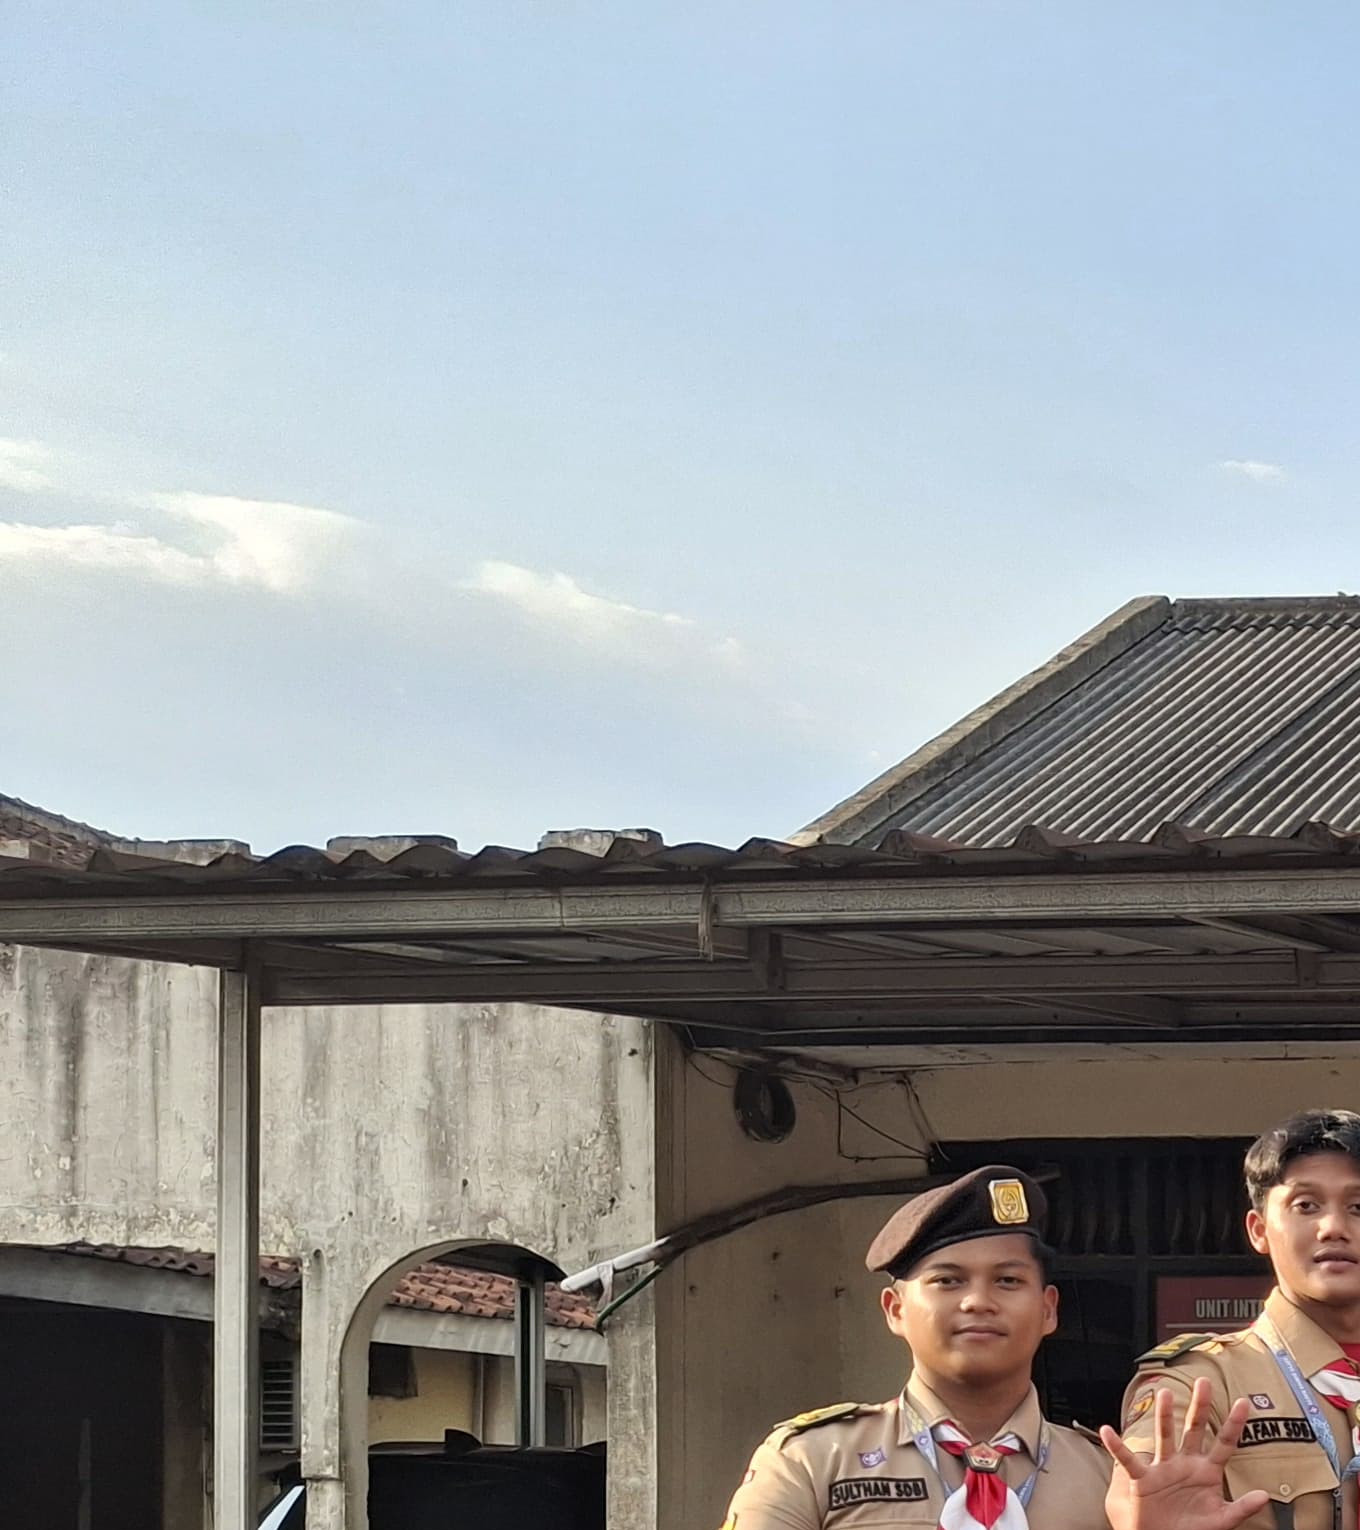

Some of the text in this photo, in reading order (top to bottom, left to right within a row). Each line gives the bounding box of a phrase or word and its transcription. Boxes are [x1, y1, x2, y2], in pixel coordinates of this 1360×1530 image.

[1196, 1299, 1230, 1318] UNIT
[1242, 1421, 1281, 1441] AFAN
[832, 1481, 891, 1504] SULTHAN
